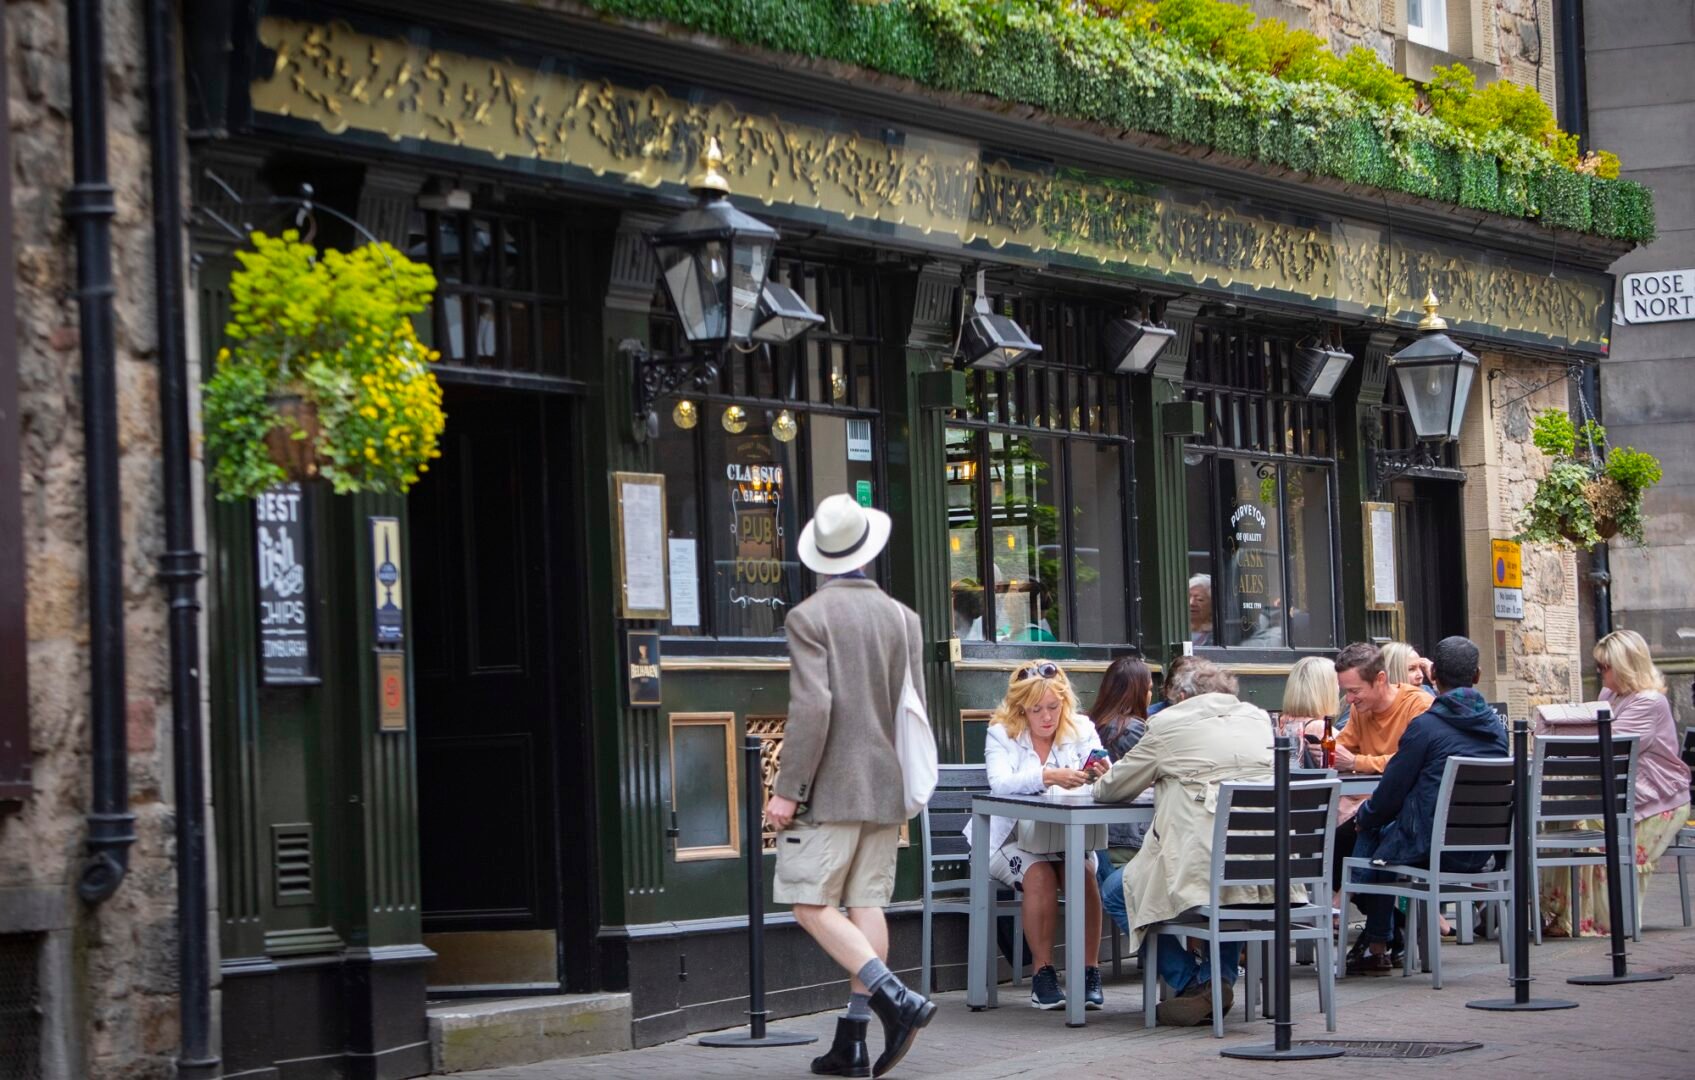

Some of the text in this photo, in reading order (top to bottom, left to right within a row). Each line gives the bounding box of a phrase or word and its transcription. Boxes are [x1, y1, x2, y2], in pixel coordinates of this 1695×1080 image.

[1631, 275, 1684, 297] ROSE
[1635, 295, 1694, 318] NORT
[1230, 503, 1266, 529] PURVEYOR
[742, 516, 772, 543] PUB
[1235, 532, 1262, 543] OF QUALITY
[1237, 549, 1265, 568] CASK
[735, 556, 781, 584] FOOD
[1238, 574, 1264, 594] ALES
[630, 664, 659, 679] BELHAVEN
